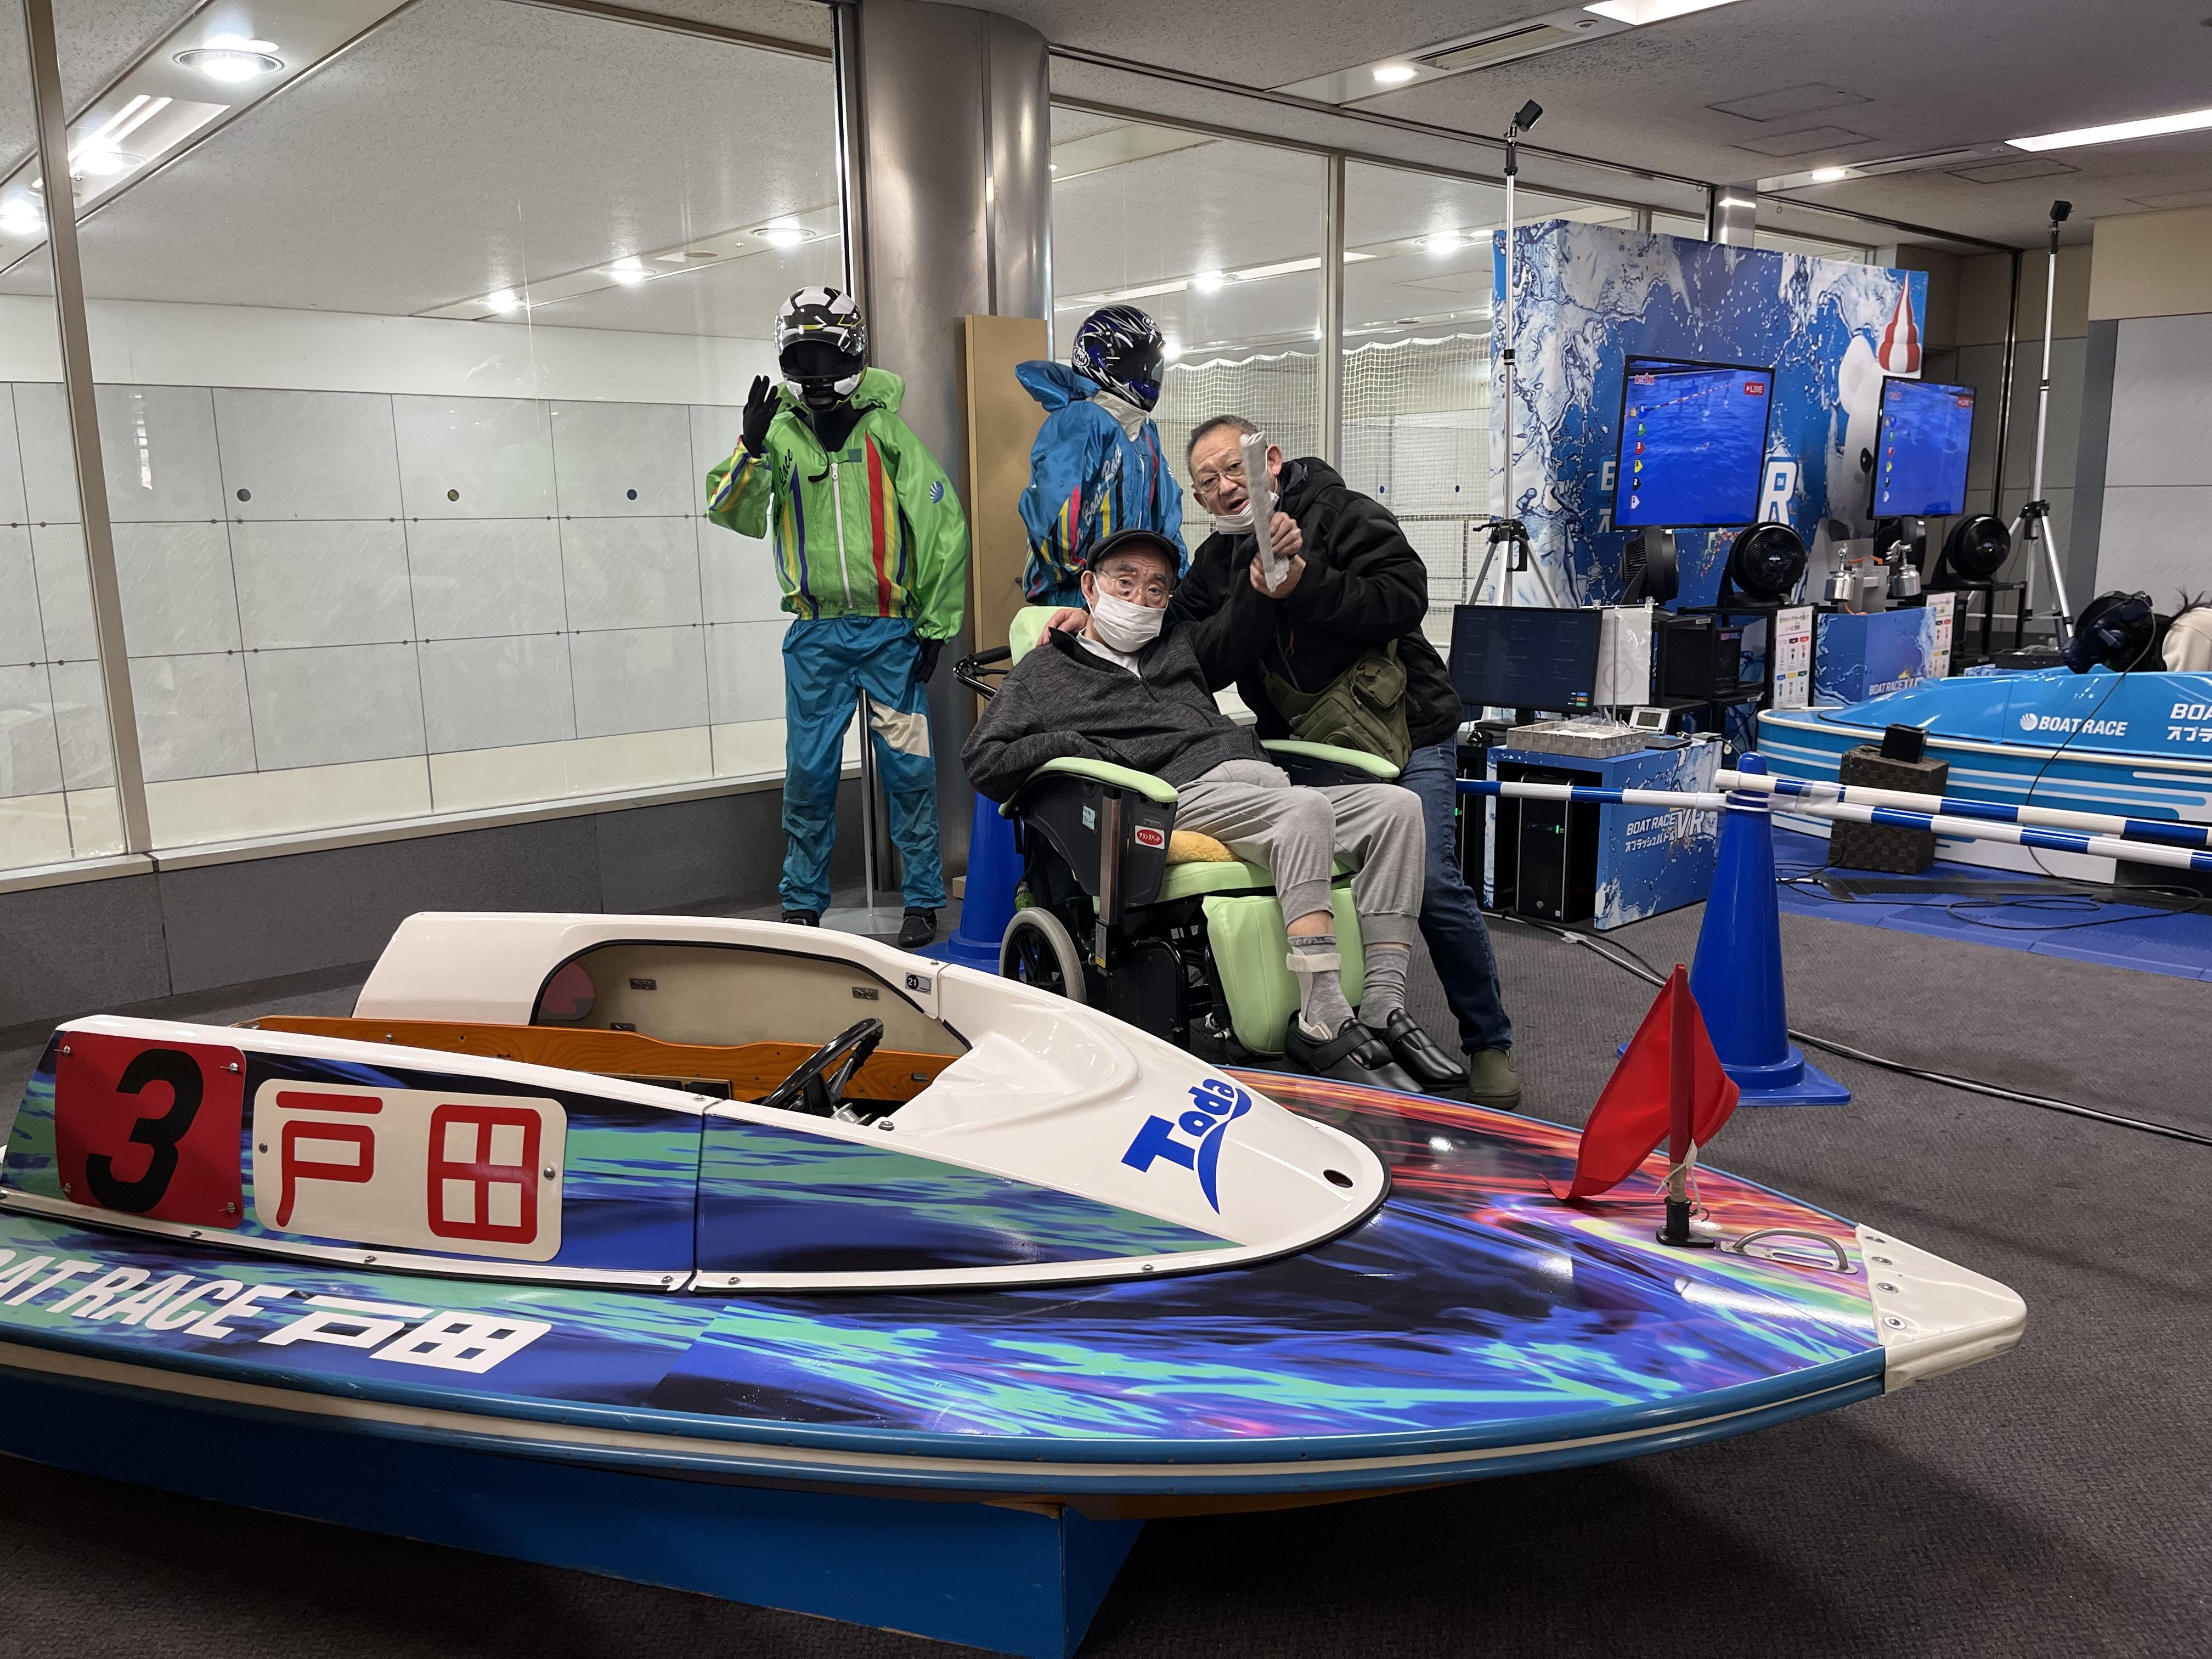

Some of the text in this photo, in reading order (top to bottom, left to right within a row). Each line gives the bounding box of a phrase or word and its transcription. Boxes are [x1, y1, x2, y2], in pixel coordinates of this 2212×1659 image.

[1750, 385, 1763, 393] LIVE
[1082, 482, 1104, 527] Boat
[1868, 682, 1887, 696] BOAT
[1886, 679, 1904, 692] RACE
[2038, 716, 2129, 736] BOAT RACE
[1626, 819, 1652, 836] BOAT
[1651, 814, 1675, 830] RACE
[908, 978, 917, 987] 21
[86, 1048, 204, 1214] 3
[1120, 1078, 1235, 1173] Toda
[275, 1091, 541, 1245] 戸田
[46, 1266, 295, 1339] RACE
[258, 1295, 552, 1374] 戸田
